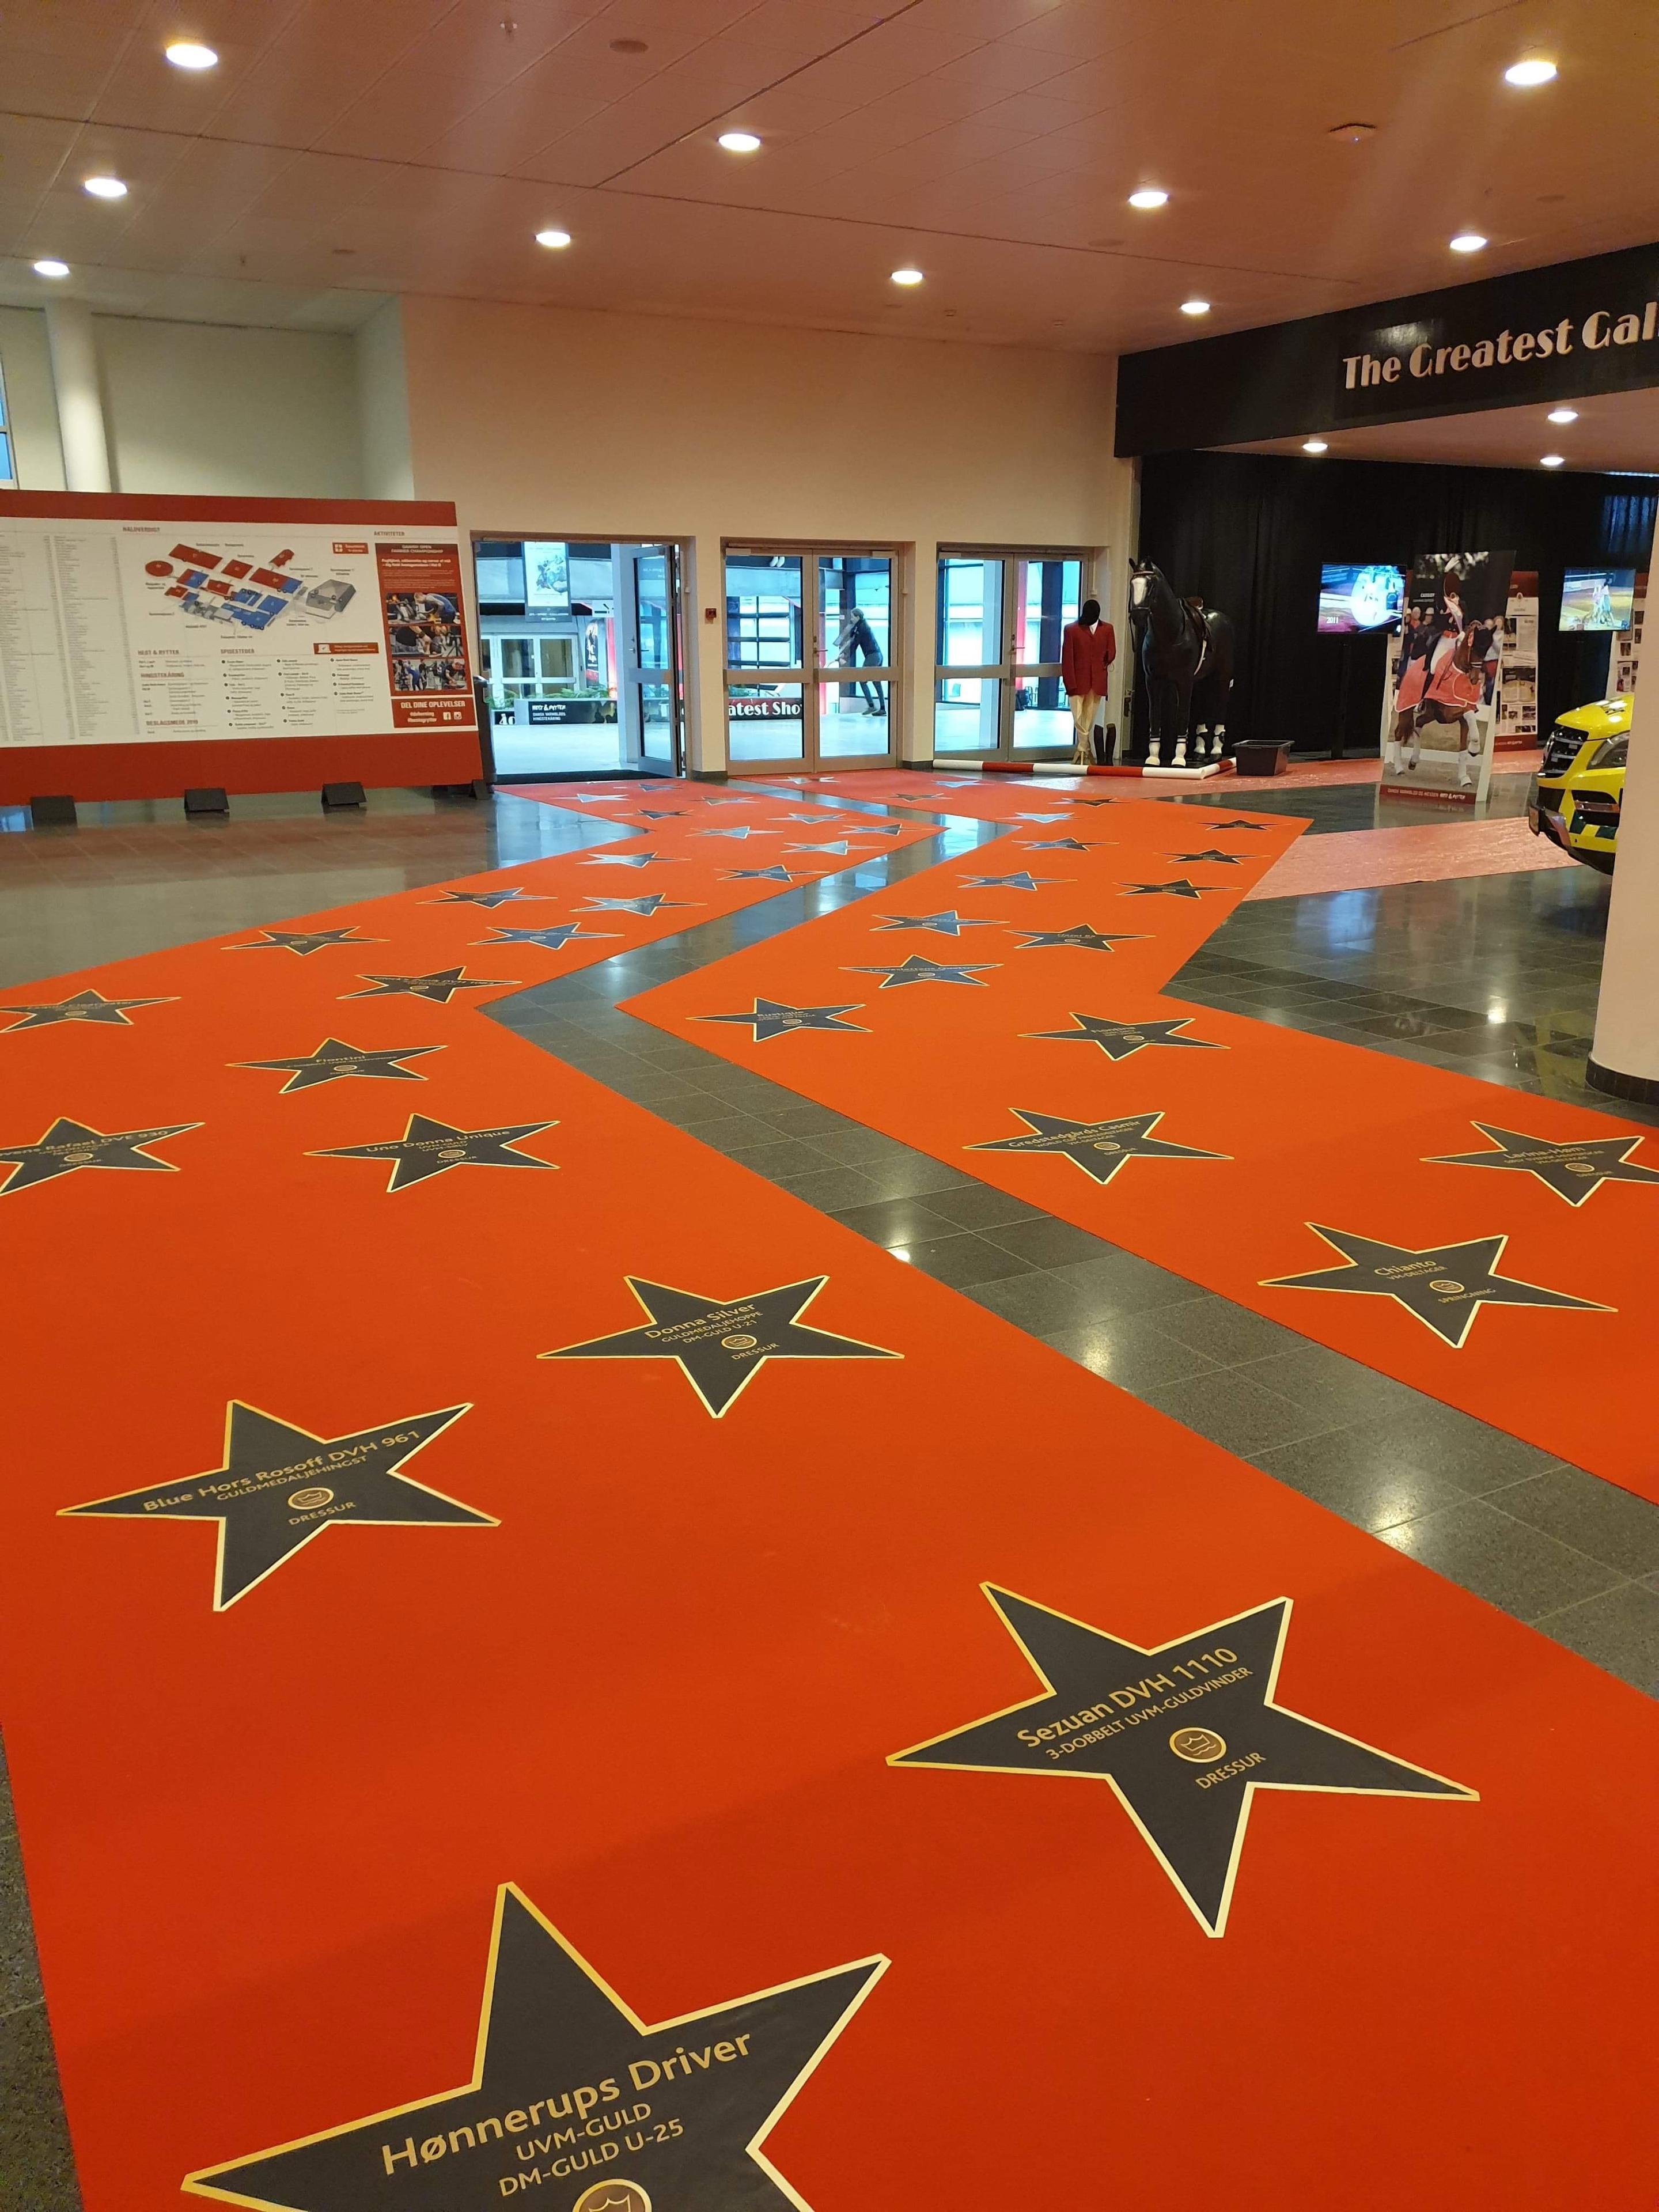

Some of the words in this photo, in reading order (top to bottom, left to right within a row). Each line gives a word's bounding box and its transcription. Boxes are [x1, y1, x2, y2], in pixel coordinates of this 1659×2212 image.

[1343, 354, 1401, 389] The
[1409, 318, 1574, 379] Greatest
[729, 702, 770, 716] atest
[772, 702, 802, 715] Sho
[46, 1139, 95, 1150] Rafael
[138, 1130, 168, 1138] 930
[1099, 1120, 1141, 1131] Casmir
[366, 1144, 399, 1153] Uno
[403, 1137, 453, 1147] Donna
[456, 1131, 511, 1141] Unique
[436, 1156, 478, 1164] DRESSUR
[1374, 1260, 1437, 1276] Chianto
[1437, 1288, 1497, 1304] SPRINGNING
[644, 1317, 707, 1339] Donna
[706, 1304, 756, 1321] Silver
[661, 1311, 764, 1343] GULDMEDALJEHOPPE
[682, 1325, 733, 1344] DM-GULD
[732, 1319, 758, 1330] U-21
[731, 1343, 781, 1360] DRESSUR
[142, 1492, 194, 1512] Blue
[198, 1477, 252, 1498] Hors
[255, 1455, 324, 1482] Rosoff
[327, 1442, 378, 1463] DVH
[381, 1430, 421, 1447] 961
[217, 1455, 368, 1501] GULDMEDALJEHINGST
[288, 1502, 357, 1526] DRESSUR
[1016, 1701, 1115, 1748] Sezuan
[1108, 1673, 1177, 1710] DVH
[1172, 1646, 1238, 1680] 1110
[1046, 1719, 1126, 1760] 3-DOBBELT
[1126, 1666, 1254, 1727] UVM-GULDVINDER
[1195, 1751, 1267, 1790] DRESSUR
[381, 2077, 621, 2176] Hønnerups
[627, 2032, 752, 2092] Driver
[516, 2102, 652, 2162] UVM-GULD
[498, 2142, 620, 2198] DM-GULD
[626, 2118, 685, 2153] U-25
